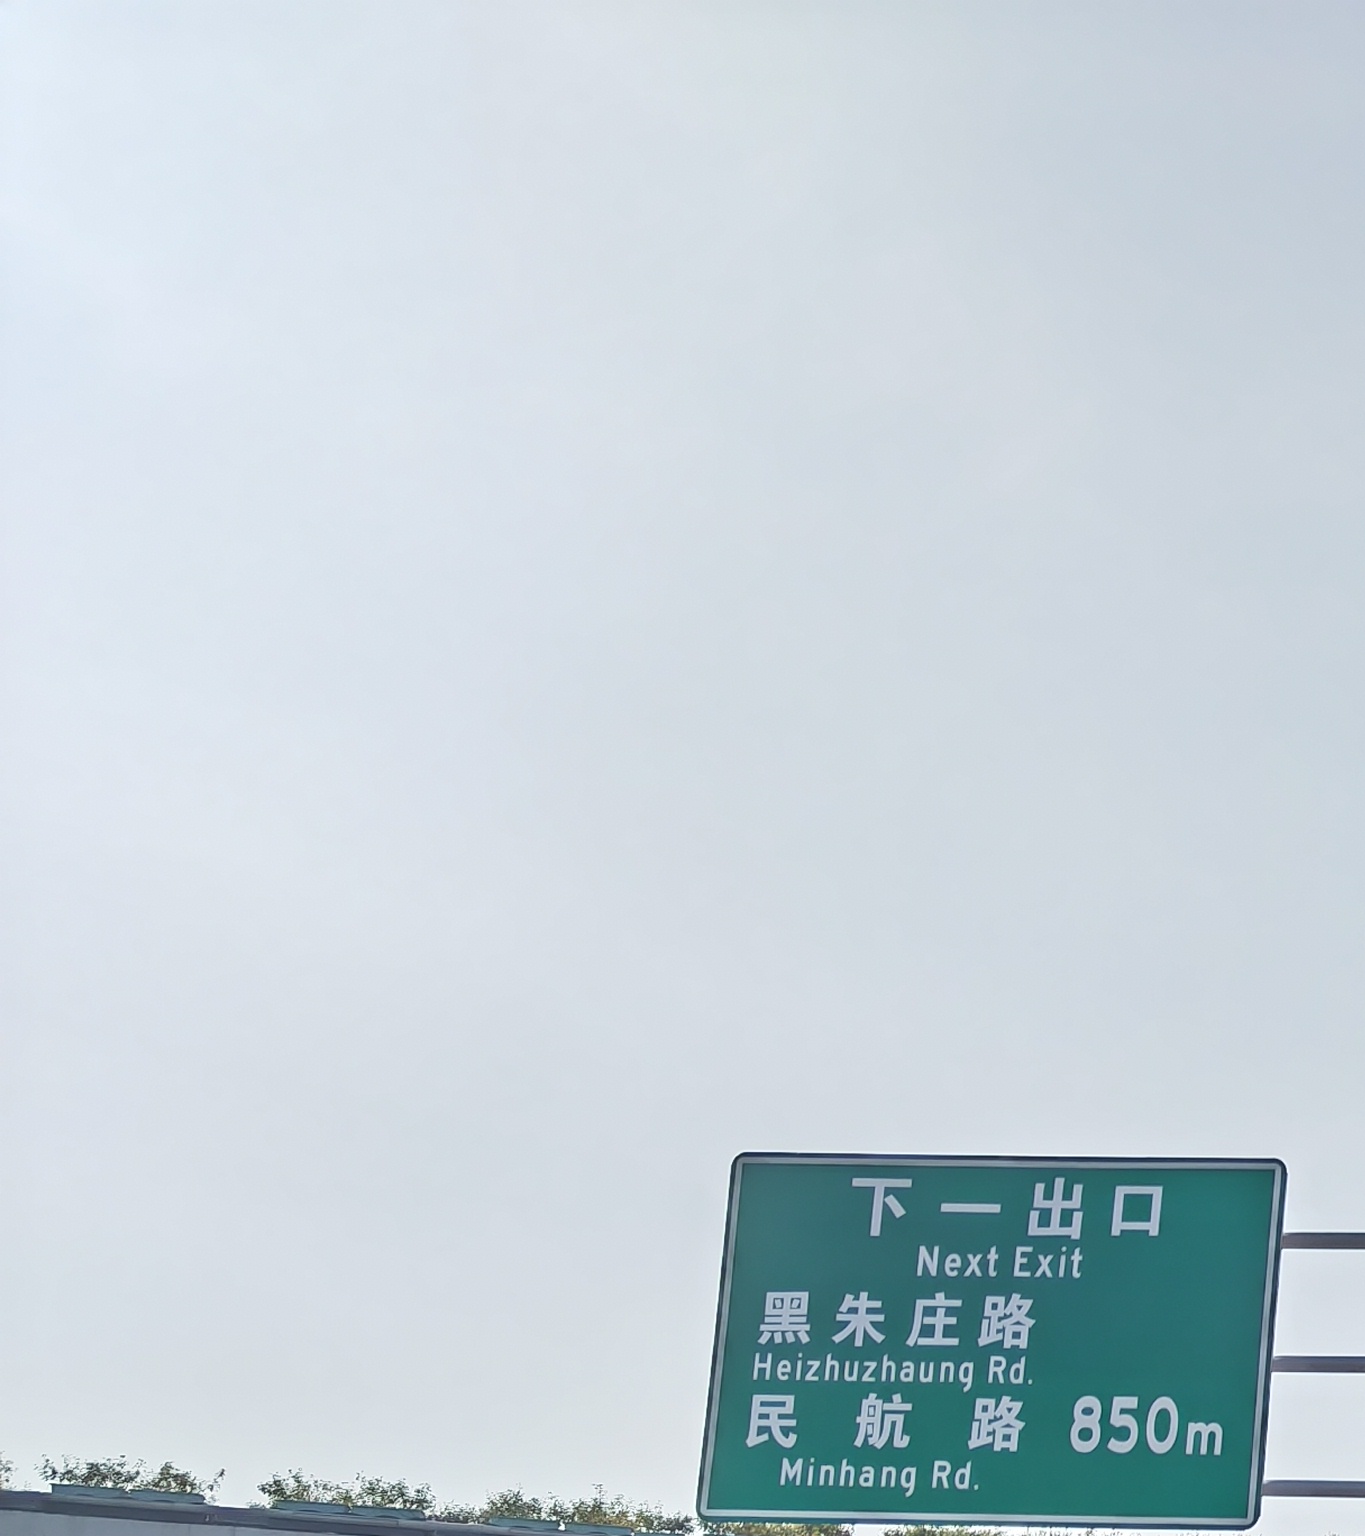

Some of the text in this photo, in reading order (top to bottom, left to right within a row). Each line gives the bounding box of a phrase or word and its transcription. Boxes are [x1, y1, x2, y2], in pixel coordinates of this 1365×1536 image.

[851, 1177, 1164, 1240] 下一出口
[916, 1245, 1083, 1279] Next Exit
[757, 1291, 1036, 1350] 黑朱庄路
[752, 1352, 1034, 1393] Heizhuzhaung Rd.
[745, 1392, 1223, 1456] 民航路 850m
[779, 1457, 979, 1498] Minhang Rd.
